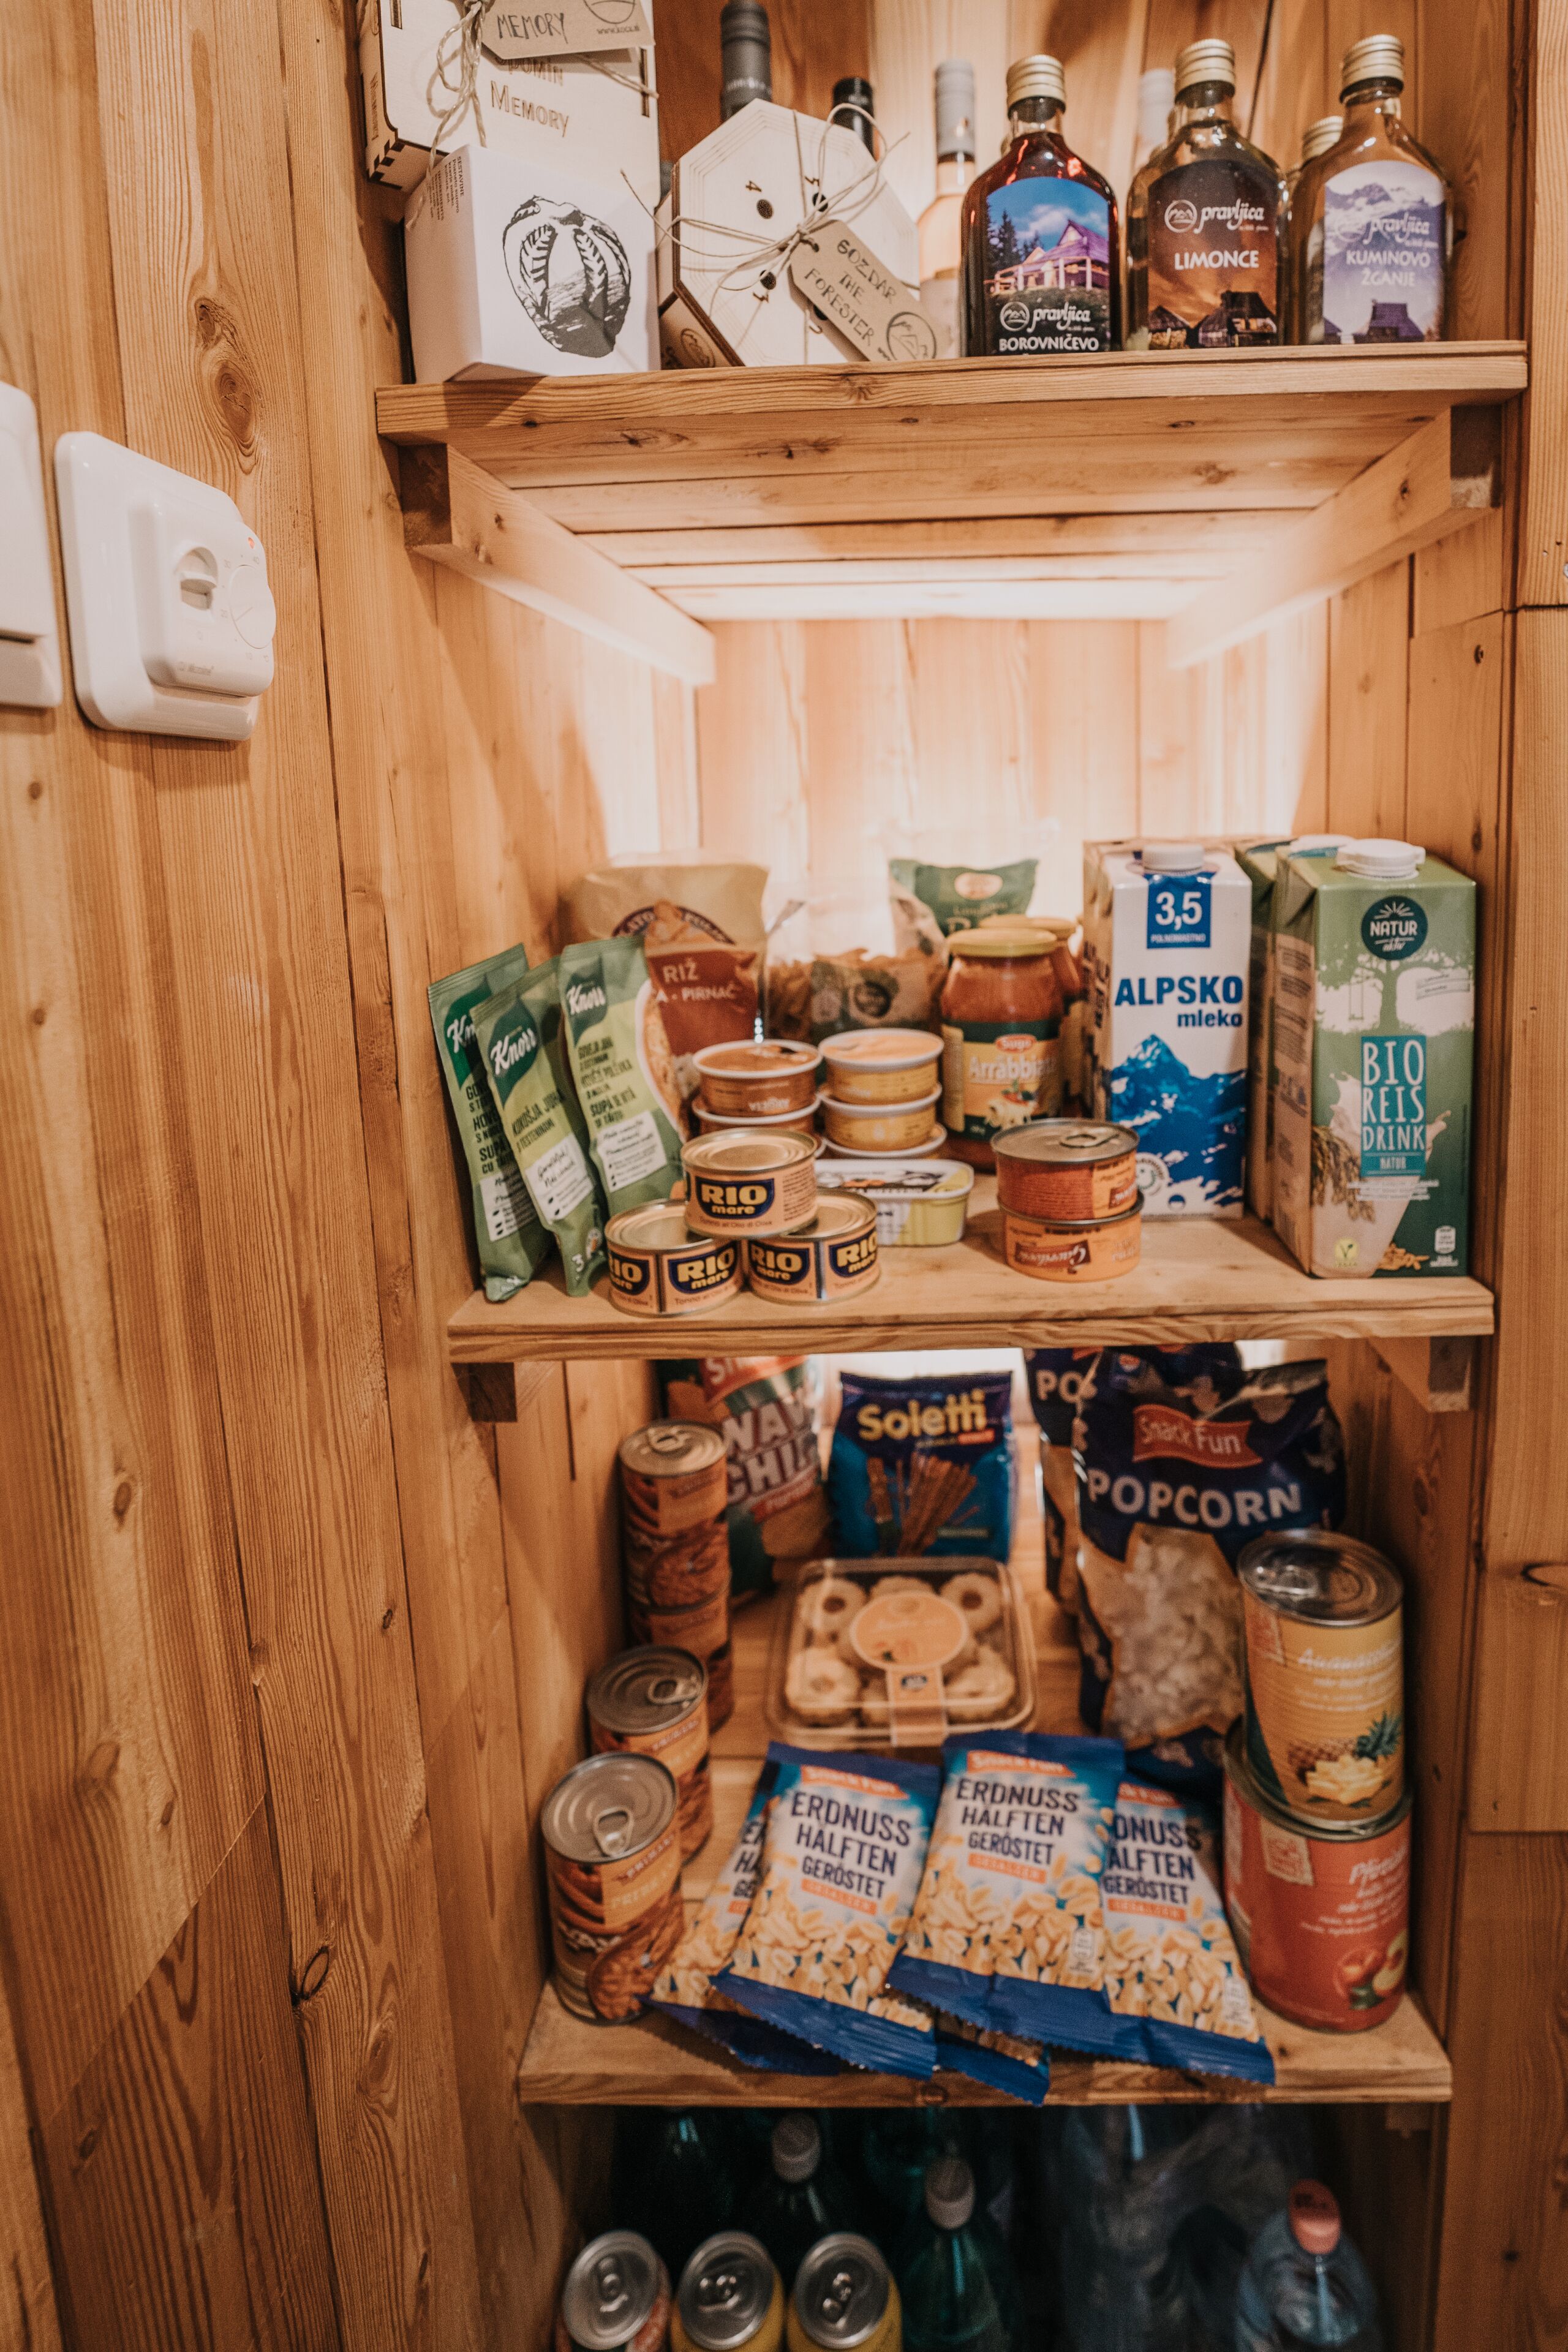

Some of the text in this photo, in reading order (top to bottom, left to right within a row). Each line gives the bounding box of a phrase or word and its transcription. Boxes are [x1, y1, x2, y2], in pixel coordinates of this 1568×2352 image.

[497, 13, 568, 44] MEMORY
[495, 56, 564, 86] POMIN
[1194, 198, 1265, 234] pravljica
[1363, 212, 1431, 244] pravljica
[1174, 250, 1259, 270] LIMONCE
[1346, 249, 1431, 267] KUMINOVO
[839, 271, 866, 305] THE
[1362, 268, 1416, 286] ŽGANJE
[804, 268, 875, 347] FORESTER
[1027, 302, 1091, 333] pravljica
[999, 333, 1099, 352] BOROVNIČEVO
[1155, 891, 1202, 930] 3,5
[1370, 920, 1418, 937] NATUR
[663, 957, 699, 984] RIŽ
[566, 983, 606, 1016] Knorr
[1115, 975, 1243, 1006] ALPSKO
[447, 1014, 476, 1054] Kn
[1177, 1009, 1243, 1028] mleko
[491, 1028, 537, 1076] Knorr
[1363, 1039, 1425, 1088] BIO
[1363, 1085, 1425, 1124] REIS
[1362, 1124, 1426, 1153] DRINK
[1379, 1156, 1407, 1170] NATUR
[701, 1183, 767, 1206] RIO
[712, 1205, 756, 1215] mare
[677, 1247, 735, 1283] RIO
[751, 1243, 802, 1273] RIO
[837, 1231, 878, 1267] RIO
[691, 1269, 729, 1290] mare
[1036, 1371, 1084, 1403] PO
[857, 1387, 987, 1441] Soletti
[1195, 1425, 1242, 1455] Fun
[1087, 1469, 1302, 1528] POPCORN
[956, 1777, 1080, 1813] ERDNUSS
[791, 1791, 911, 1847] ERDNUSS
[1115, 1814, 1204, 1852] DNUSS
[968, 1831, 1054, 1866] GERÖSTET
[802, 1855, 885, 1899] GERÖSTET
